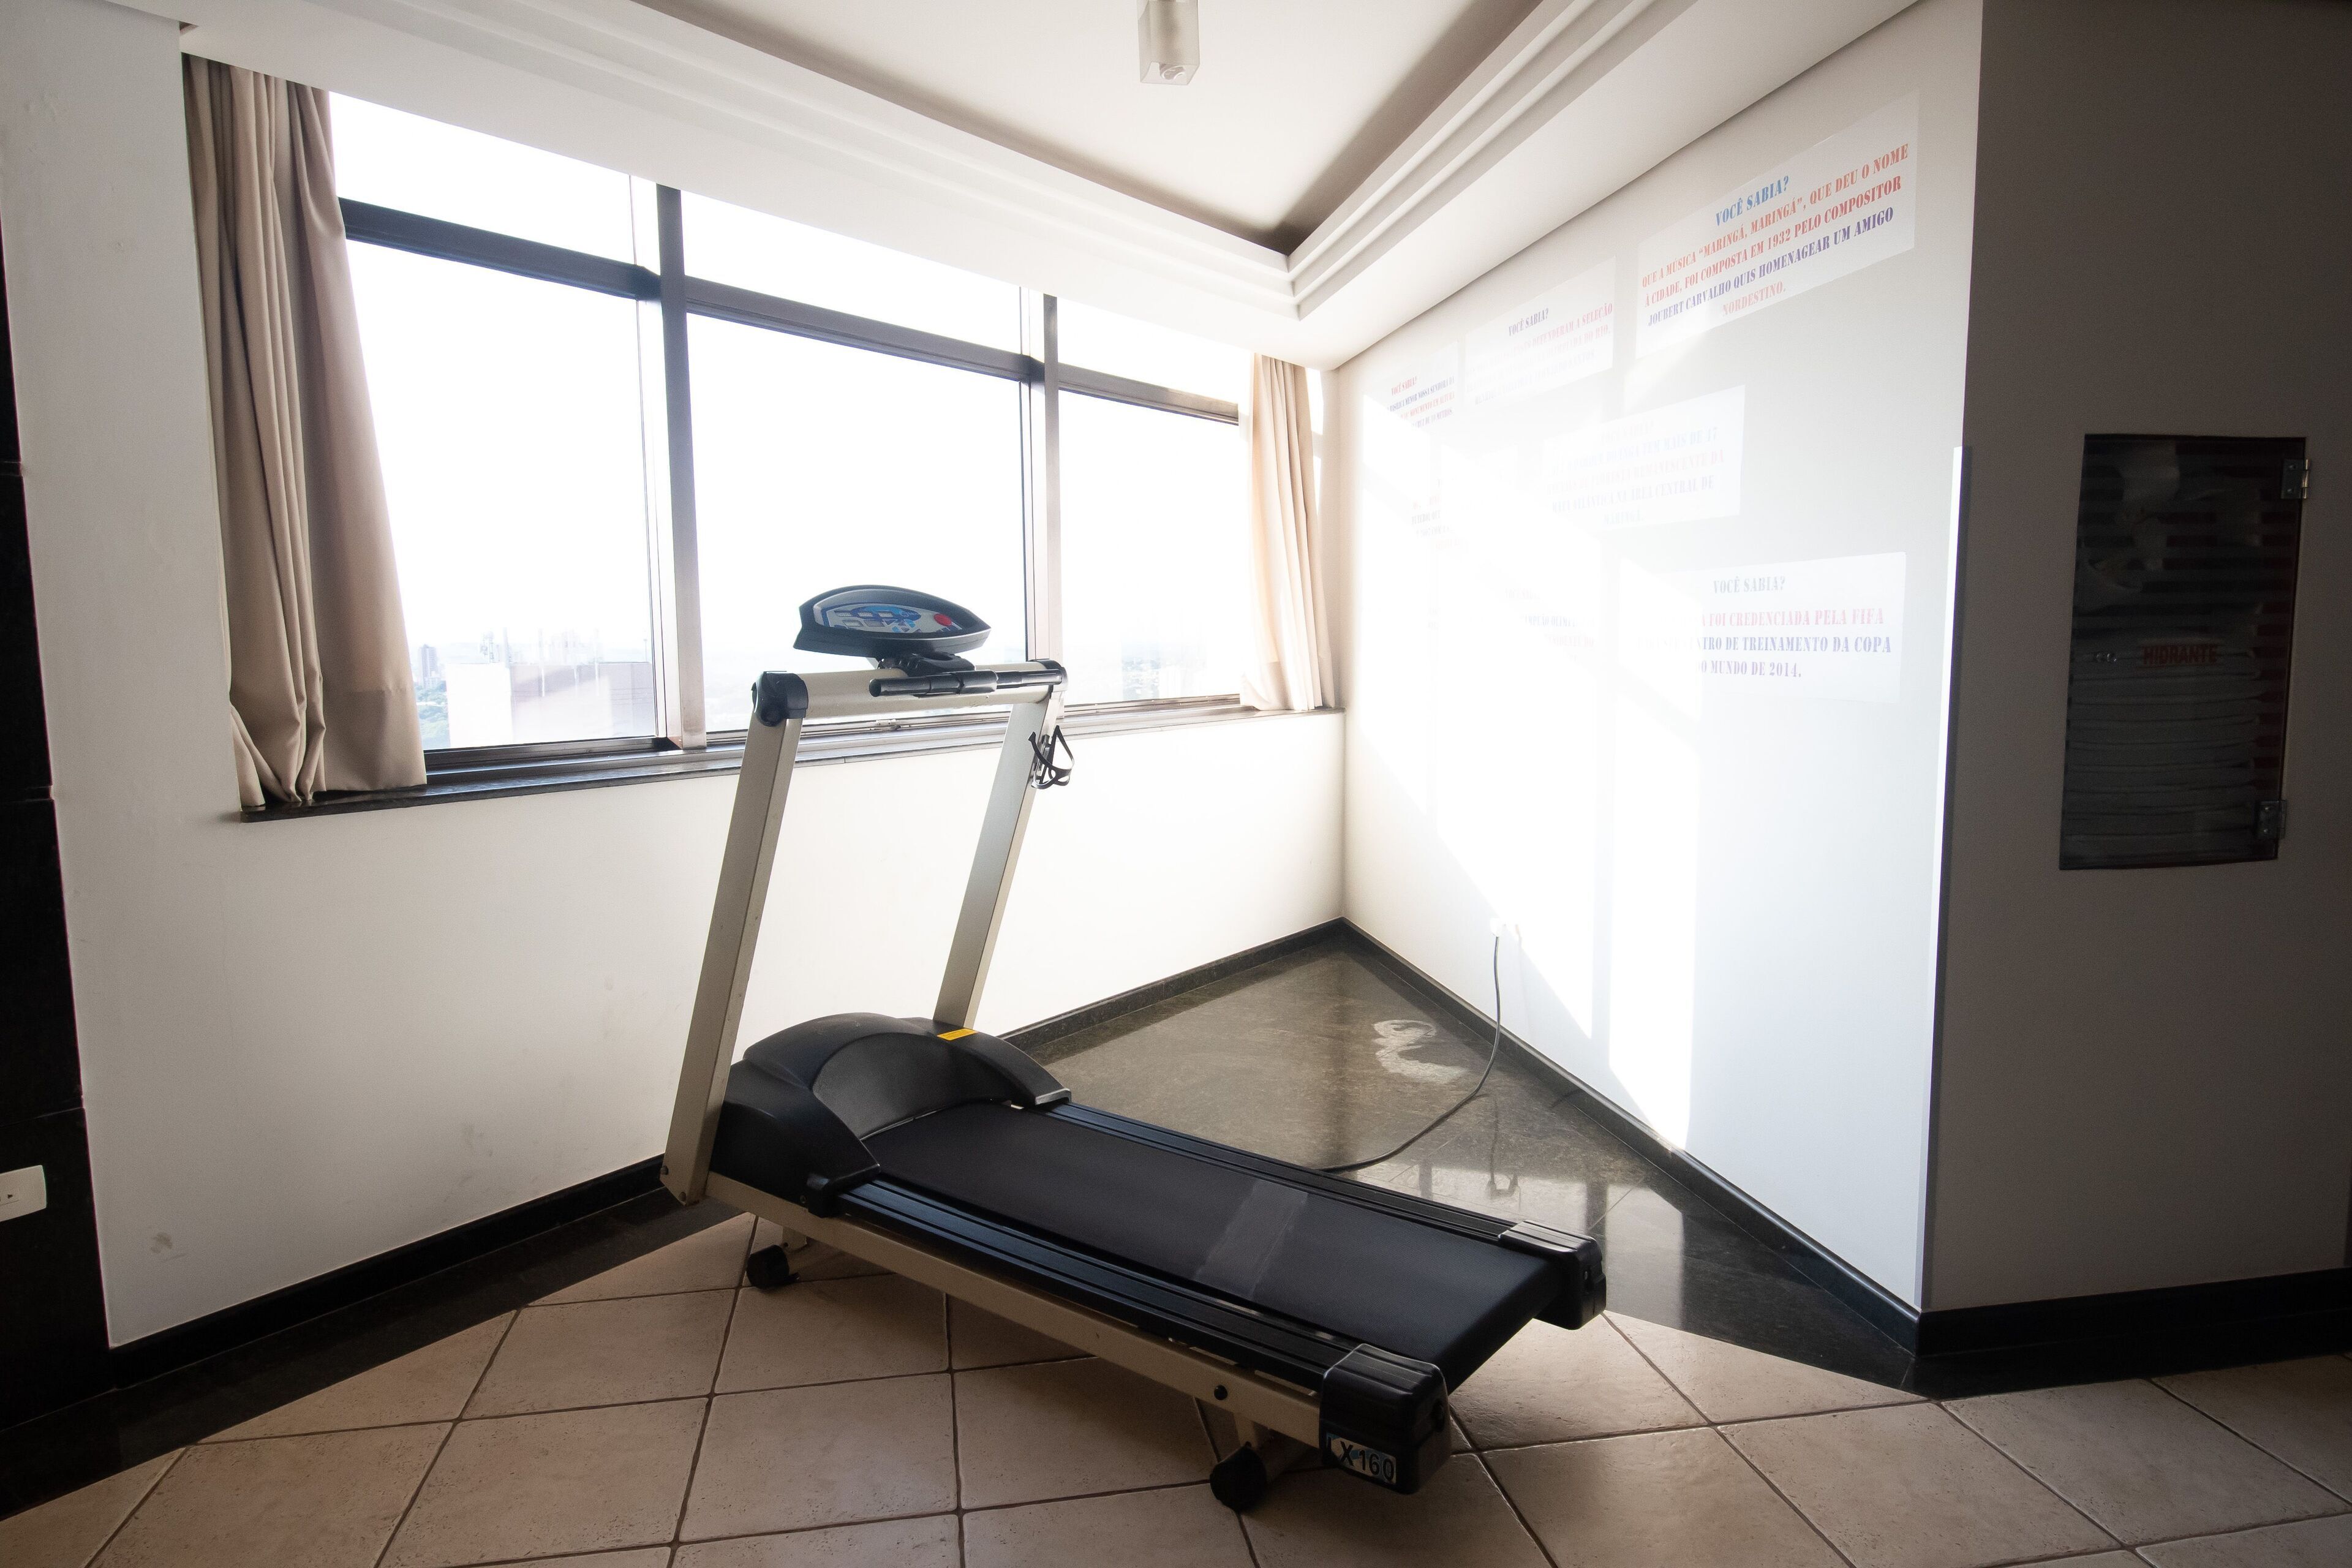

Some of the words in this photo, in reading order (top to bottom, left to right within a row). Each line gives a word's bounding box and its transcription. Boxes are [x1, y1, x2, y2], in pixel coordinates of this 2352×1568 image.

[1716, 198, 1743, 227] VOCÊ
[1747, 176, 1789, 211] SABIA?
[1642, 271, 1657, 288] QUE
[1659, 268, 1666, 280] A
[1666, 252, 1696, 276] MÚSICA
[1810, 183, 1832, 205] QUE
[1835, 169, 1858, 194] DEU
[1861, 164, 1870, 179] O
[1873, 143, 1909, 174] NOME
[1651, 281, 1683, 306] CIDADE,
[1684, 273, 1698, 289] FOI
[1701, 249, 1747, 281] COMPOSTA
[1751, 241, 1765, 258] EM
[1768, 228, 1791, 251] 1932
[1795, 214, 1822, 238] PELO
[1824, 176, 1902, 224] COMPOSITOR
[1648, 303, 1684, 326] JOUBERT
[1686, 280, 1732, 316] CARVALHO
[1734, 268, 1756, 289] QUIS
[1759, 236, 1830, 279] HOMENAGEAR
[1834, 225, 1851, 246] UM
[1854, 207, 1894, 237] AMIGO
[1722, 281, 1786, 316] NORDESTINO.
[1509, 318, 1525, 336] VOCÊ
[1526, 307, 1548, 328] SABIA?
[1582, 303, 1613, 326] SELEÇÃO
[1406, 394, 1417, 405] MENOR
[1418, 388, 1430, 399] NOSSA
[1430, 379, 1449, 394] SENHORA
[1713, 576, 1741, 594] VOCÊ
[1744, 576, 1785, 593] SABIA?
[1709, 612, 1726, 627] FOI
[1729, 610, 1811, 627] CREDENCIADA
[1814, 608, 1847, 625] PELA
[1852, 608, 1885, 625] FIFA
[1725, 636, 1739, 652] DE
[1743, 636, 1828, 653] TREINAMENTO
[1832, 636, 1850, 653] DA
[1853, 636, 1892, 654] COPA
[2143, 644, 2217, 665] HIDRANTE
[1710, 660, 1747, 676] MUNDO
[1751, 662, 1766, 677] DE
[1769, 662, 1802, 678] 2014.
